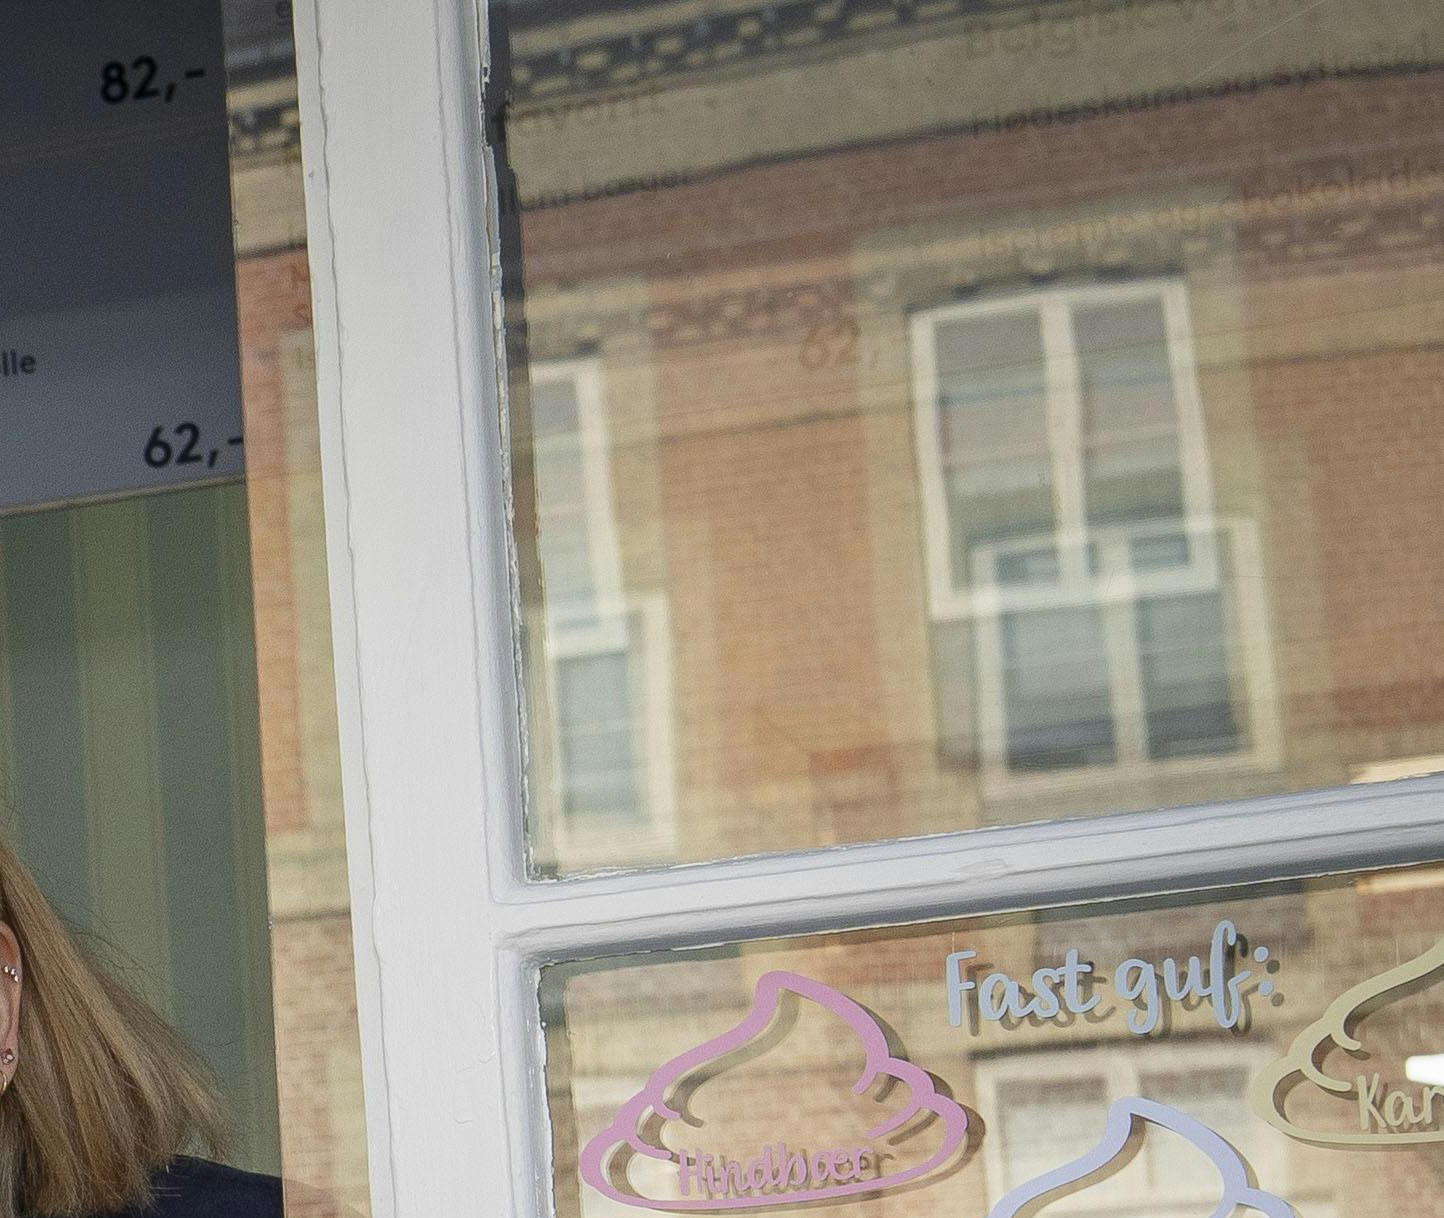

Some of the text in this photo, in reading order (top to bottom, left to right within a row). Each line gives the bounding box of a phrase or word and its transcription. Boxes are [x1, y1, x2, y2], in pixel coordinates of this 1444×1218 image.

[99, 55, 207, 105] 82,-
[143, 422, 244, 469] 62,-
[946, 920, 1274, 1035] Fast guf:
[677, 1141, 876, 1196] Hindbær
